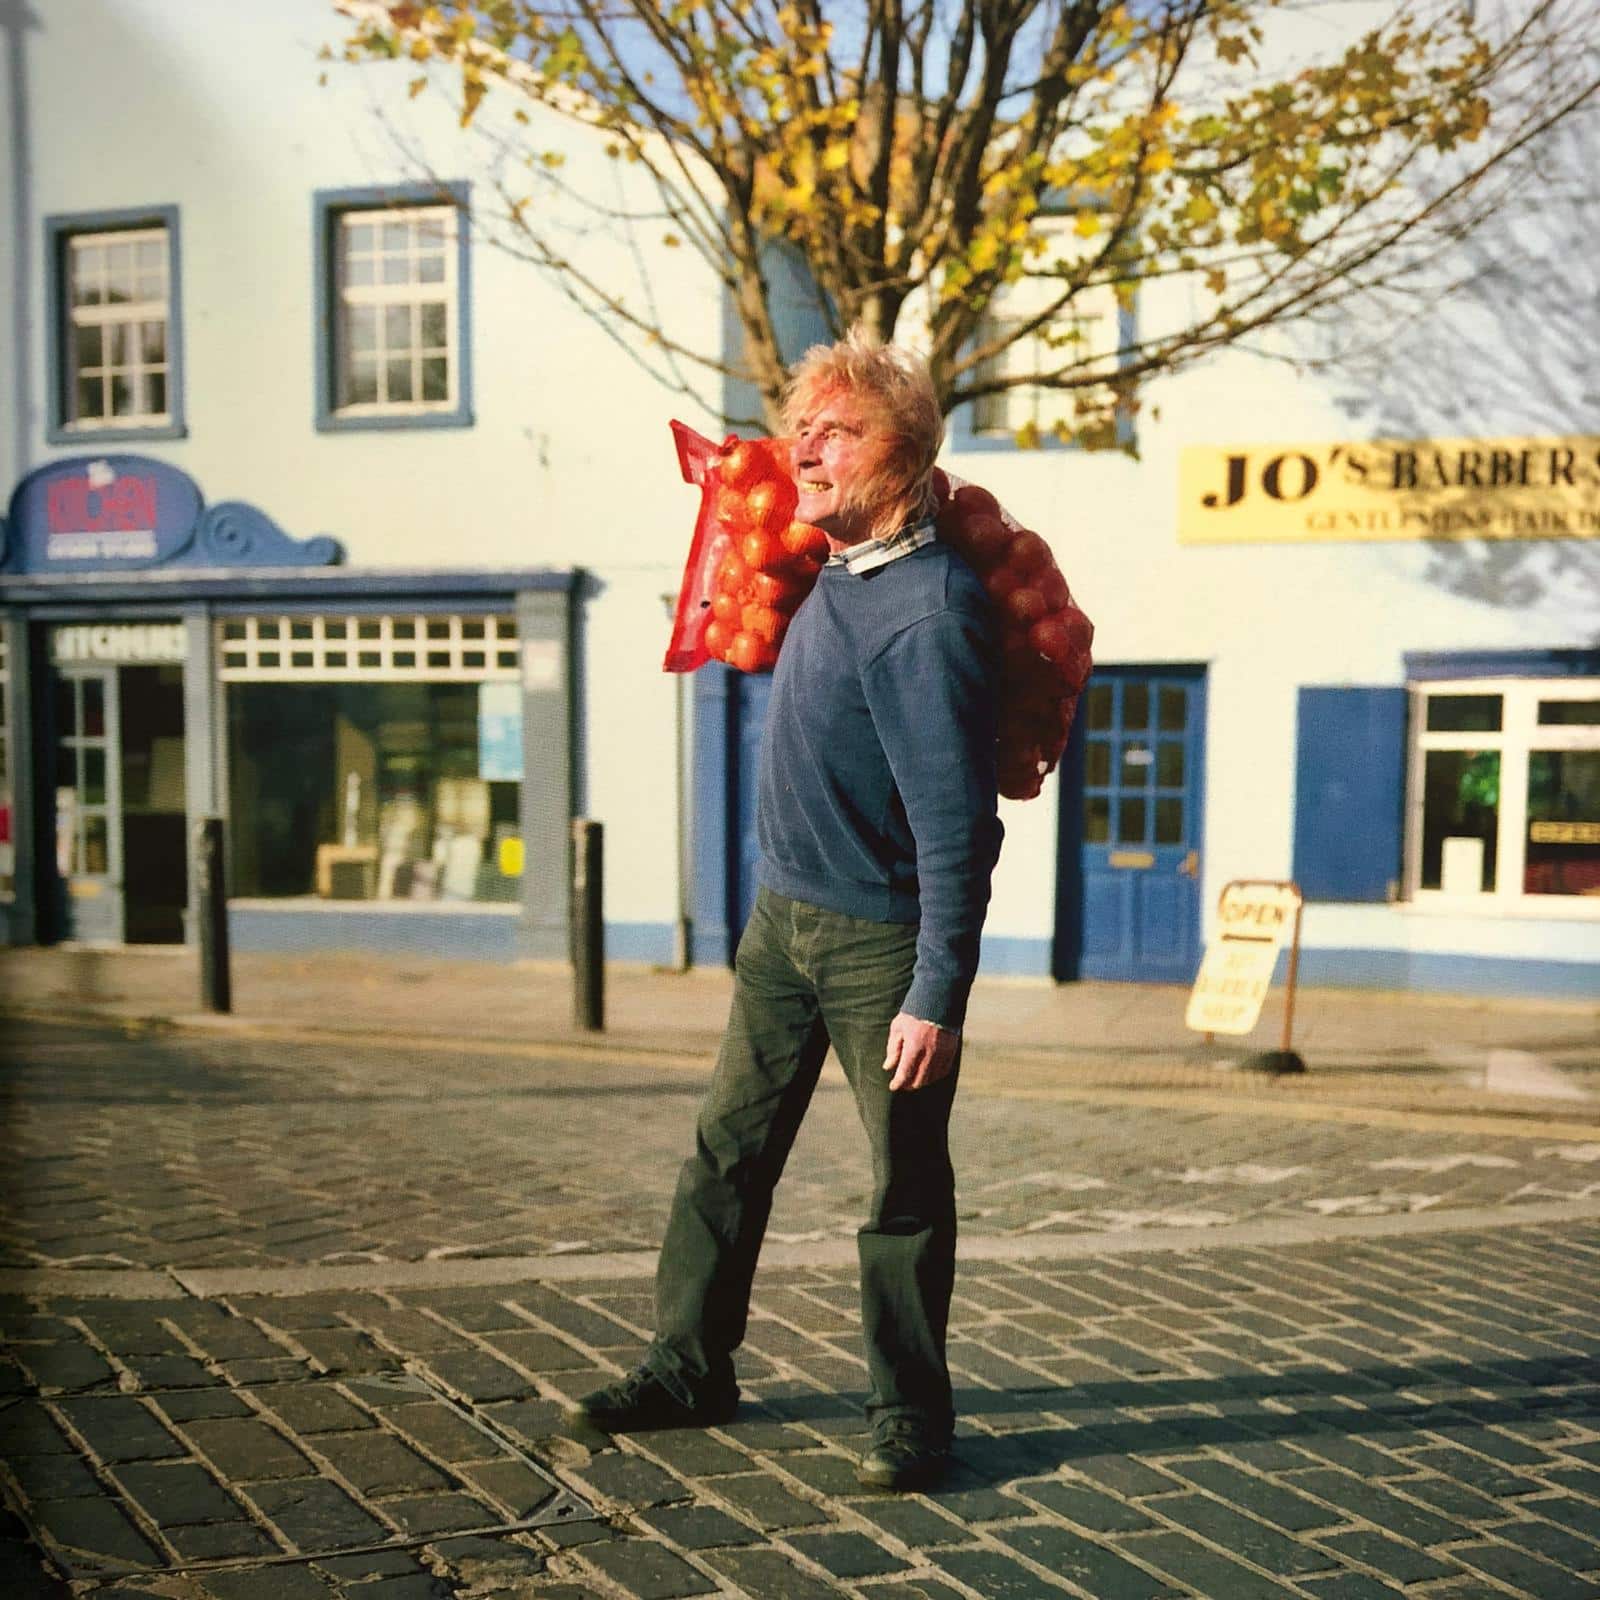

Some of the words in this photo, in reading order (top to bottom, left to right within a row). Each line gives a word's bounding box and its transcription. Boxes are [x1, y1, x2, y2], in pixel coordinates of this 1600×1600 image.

[1201, 449, 1369, 509] JO'S
[1393, 448, 1600, 488] BARBER
[1223, 901, 1287, 925] OPEN
